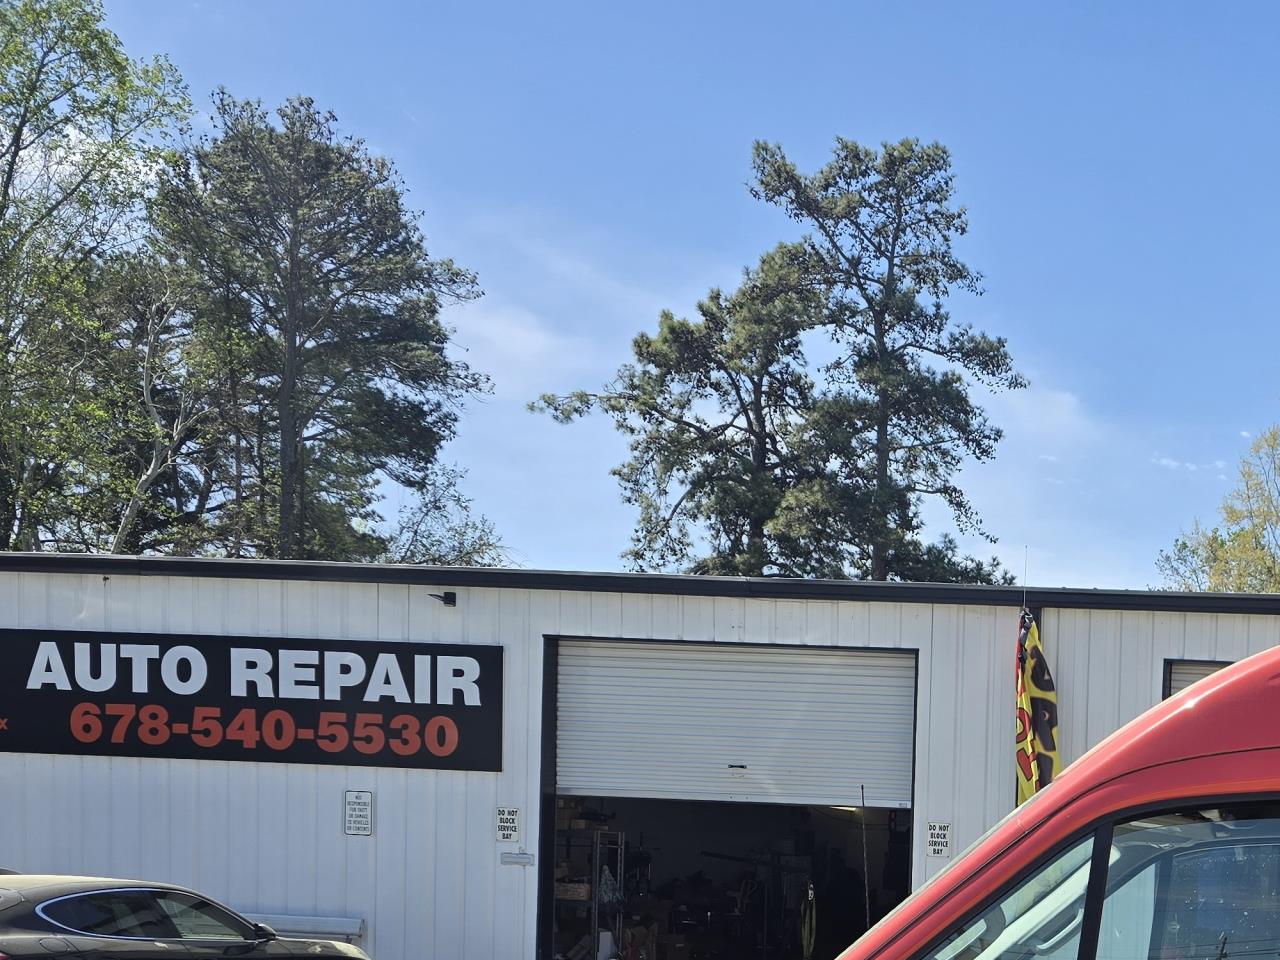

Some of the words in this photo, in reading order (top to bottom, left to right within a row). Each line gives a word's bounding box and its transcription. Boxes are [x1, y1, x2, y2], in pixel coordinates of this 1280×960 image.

[26, 641, 208, 695] AUTO
[230, 647, 482, 706] REPAIR
[69, 702, 459, 757] 678-540-5530
[499, 817, 516, 825] BLOCK
[930, 832, 947, 840] BLOCK
